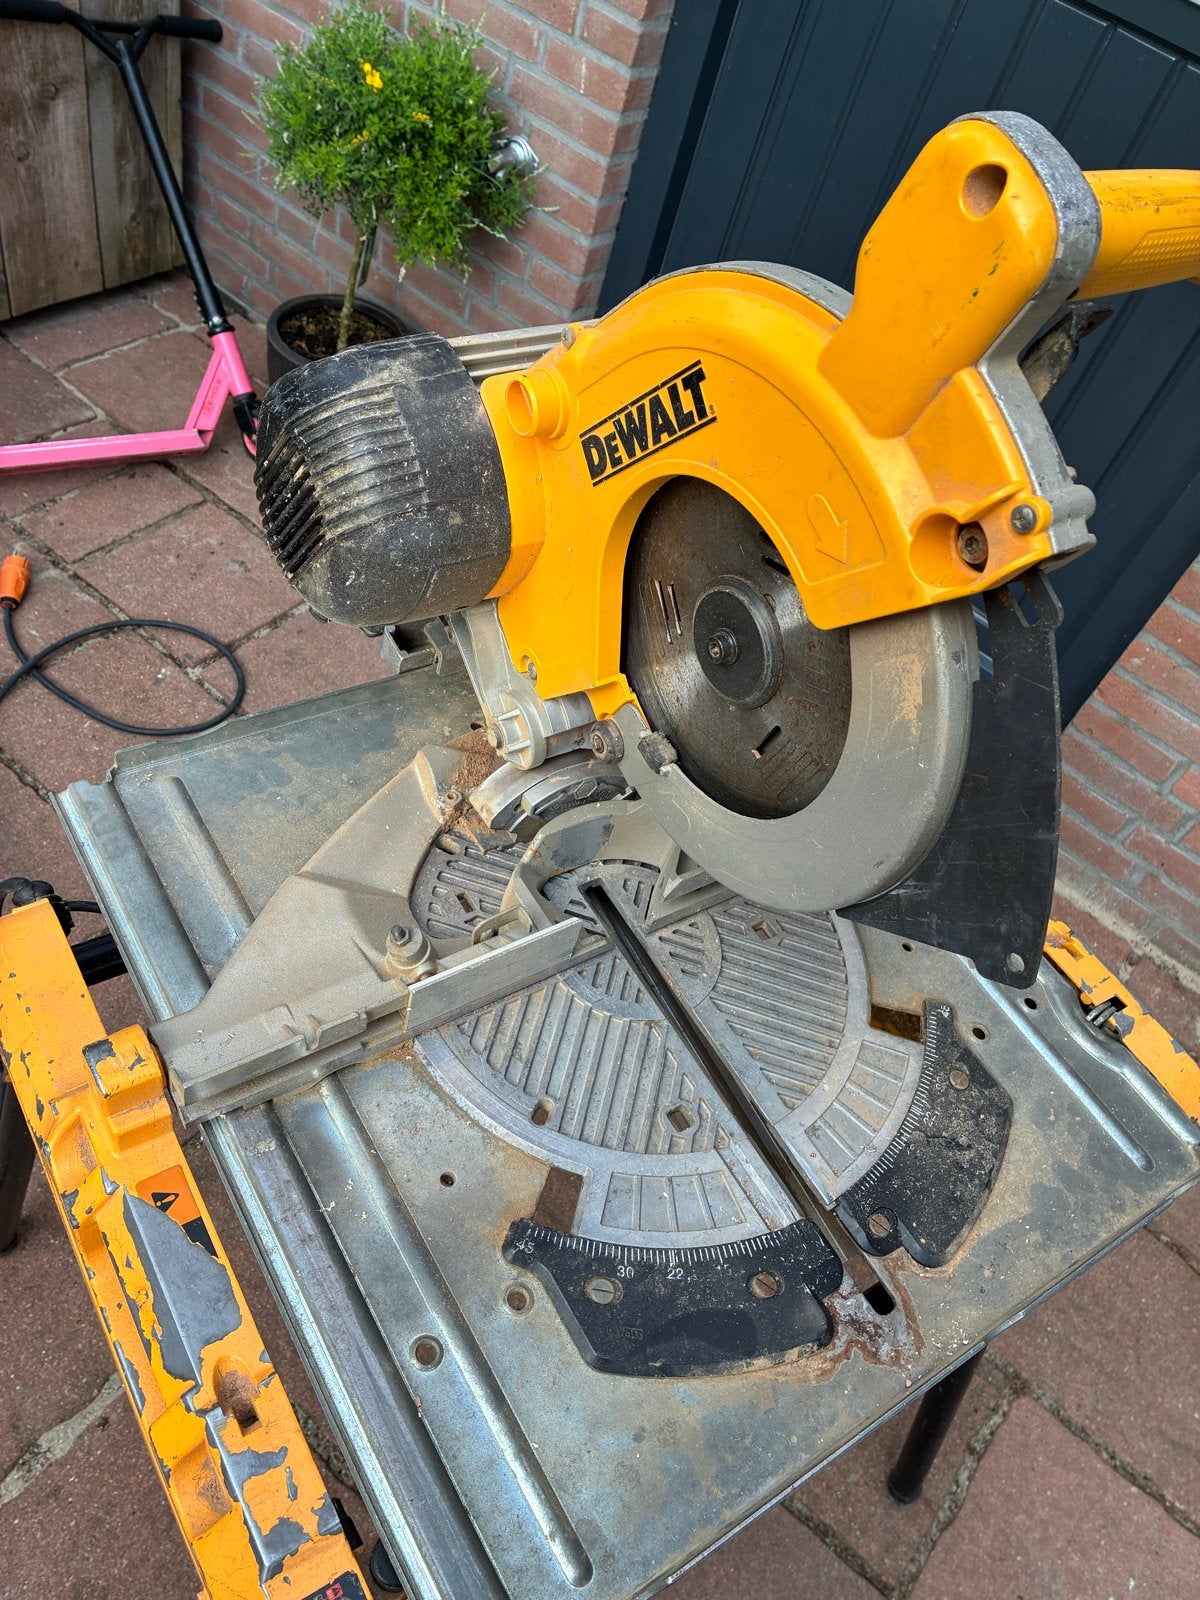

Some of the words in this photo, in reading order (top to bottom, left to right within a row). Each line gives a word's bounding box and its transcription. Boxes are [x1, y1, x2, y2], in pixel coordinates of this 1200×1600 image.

[581, 367, 708, 480] DEWALT
[513, 1239, 535, 1254] 45
[617, 1266, 634, 1278] 30
